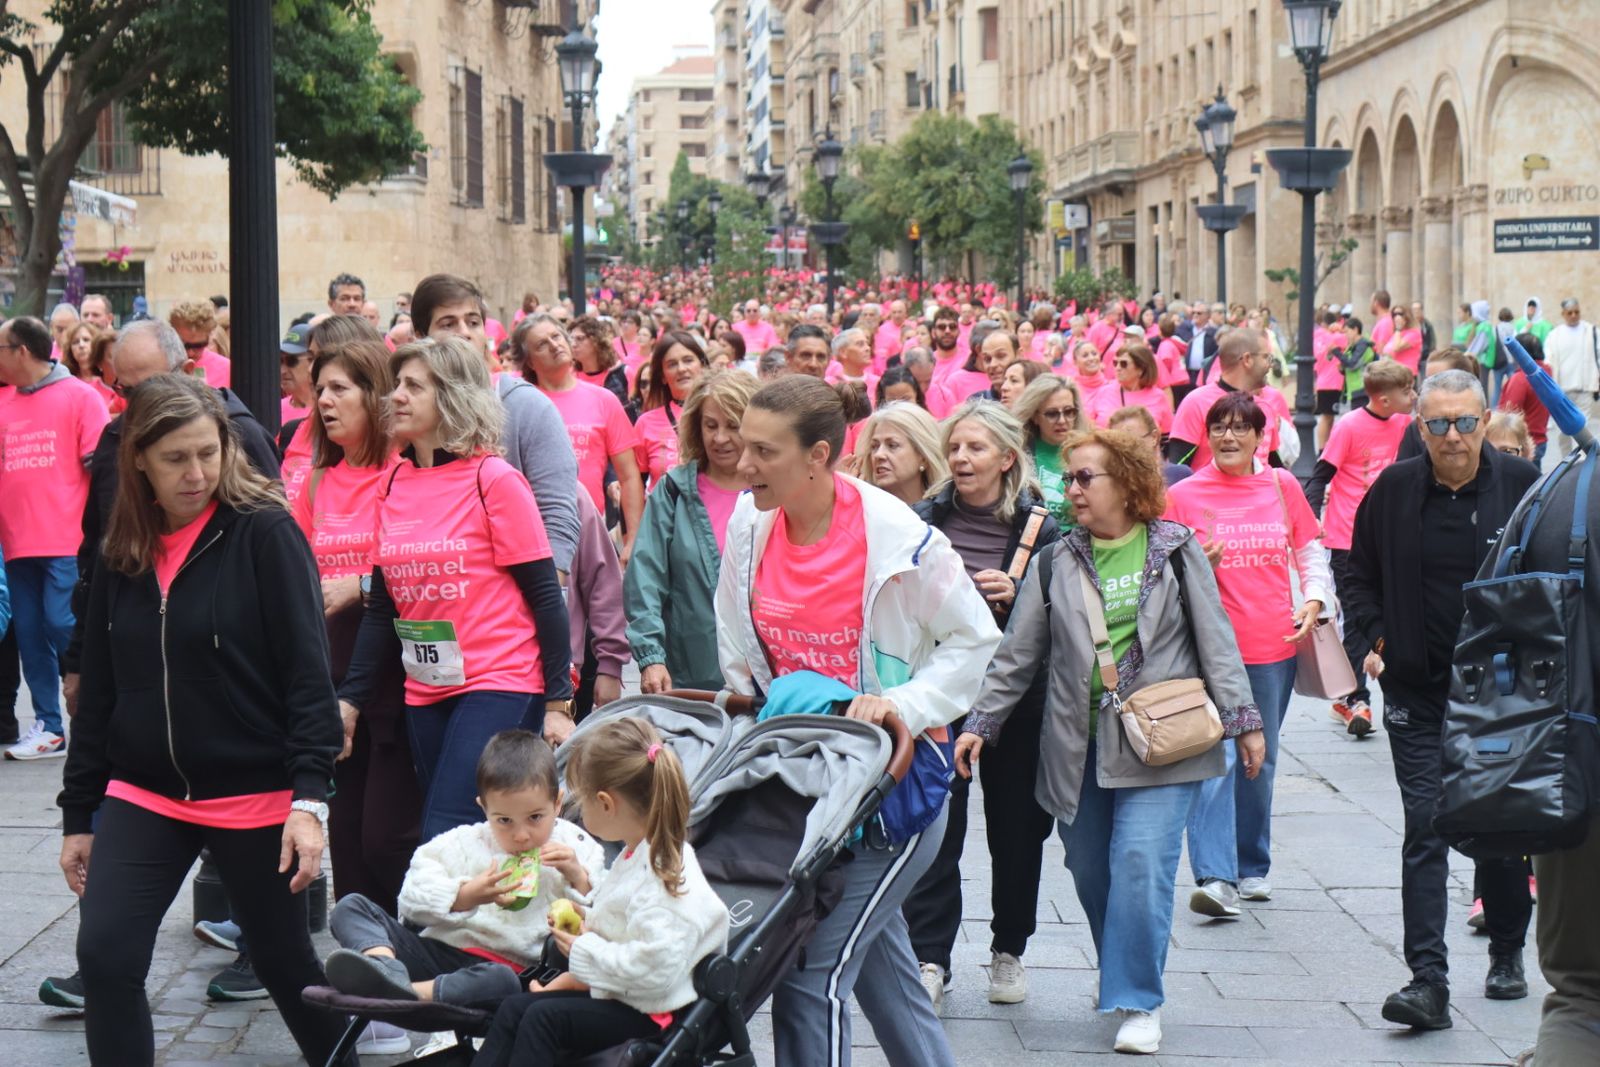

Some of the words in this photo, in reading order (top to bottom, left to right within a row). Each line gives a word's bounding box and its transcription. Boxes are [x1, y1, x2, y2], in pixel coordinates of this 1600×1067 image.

[1495, 187, 1534, 205] GRUPO
[1538, 184, 1599, 203] CURTO
[1529, 222, 1593, 233] UNIVERSITARIA
[20, 429, 57, 441] marcha
[6, 443, 41, 457] contra
[42, 440, 55, 453] el
[5, 455, 56, 472] cáncer
[1216, 523, 1235, 535] En
[315, 532, 332, 546] En
[380, 541, 397, 557] En
[400, 535, 468, 555] marcha
[1223, 535, 1276, 550] ontra
[383, 559, 440, 579] contra
[443, 555, 467, 575] el
[392, 580, 470, 603] cáncer
[757, 619, 782, 641] En
[787, 625, 862, 646] march
[414, 643, 439, 664] 675
